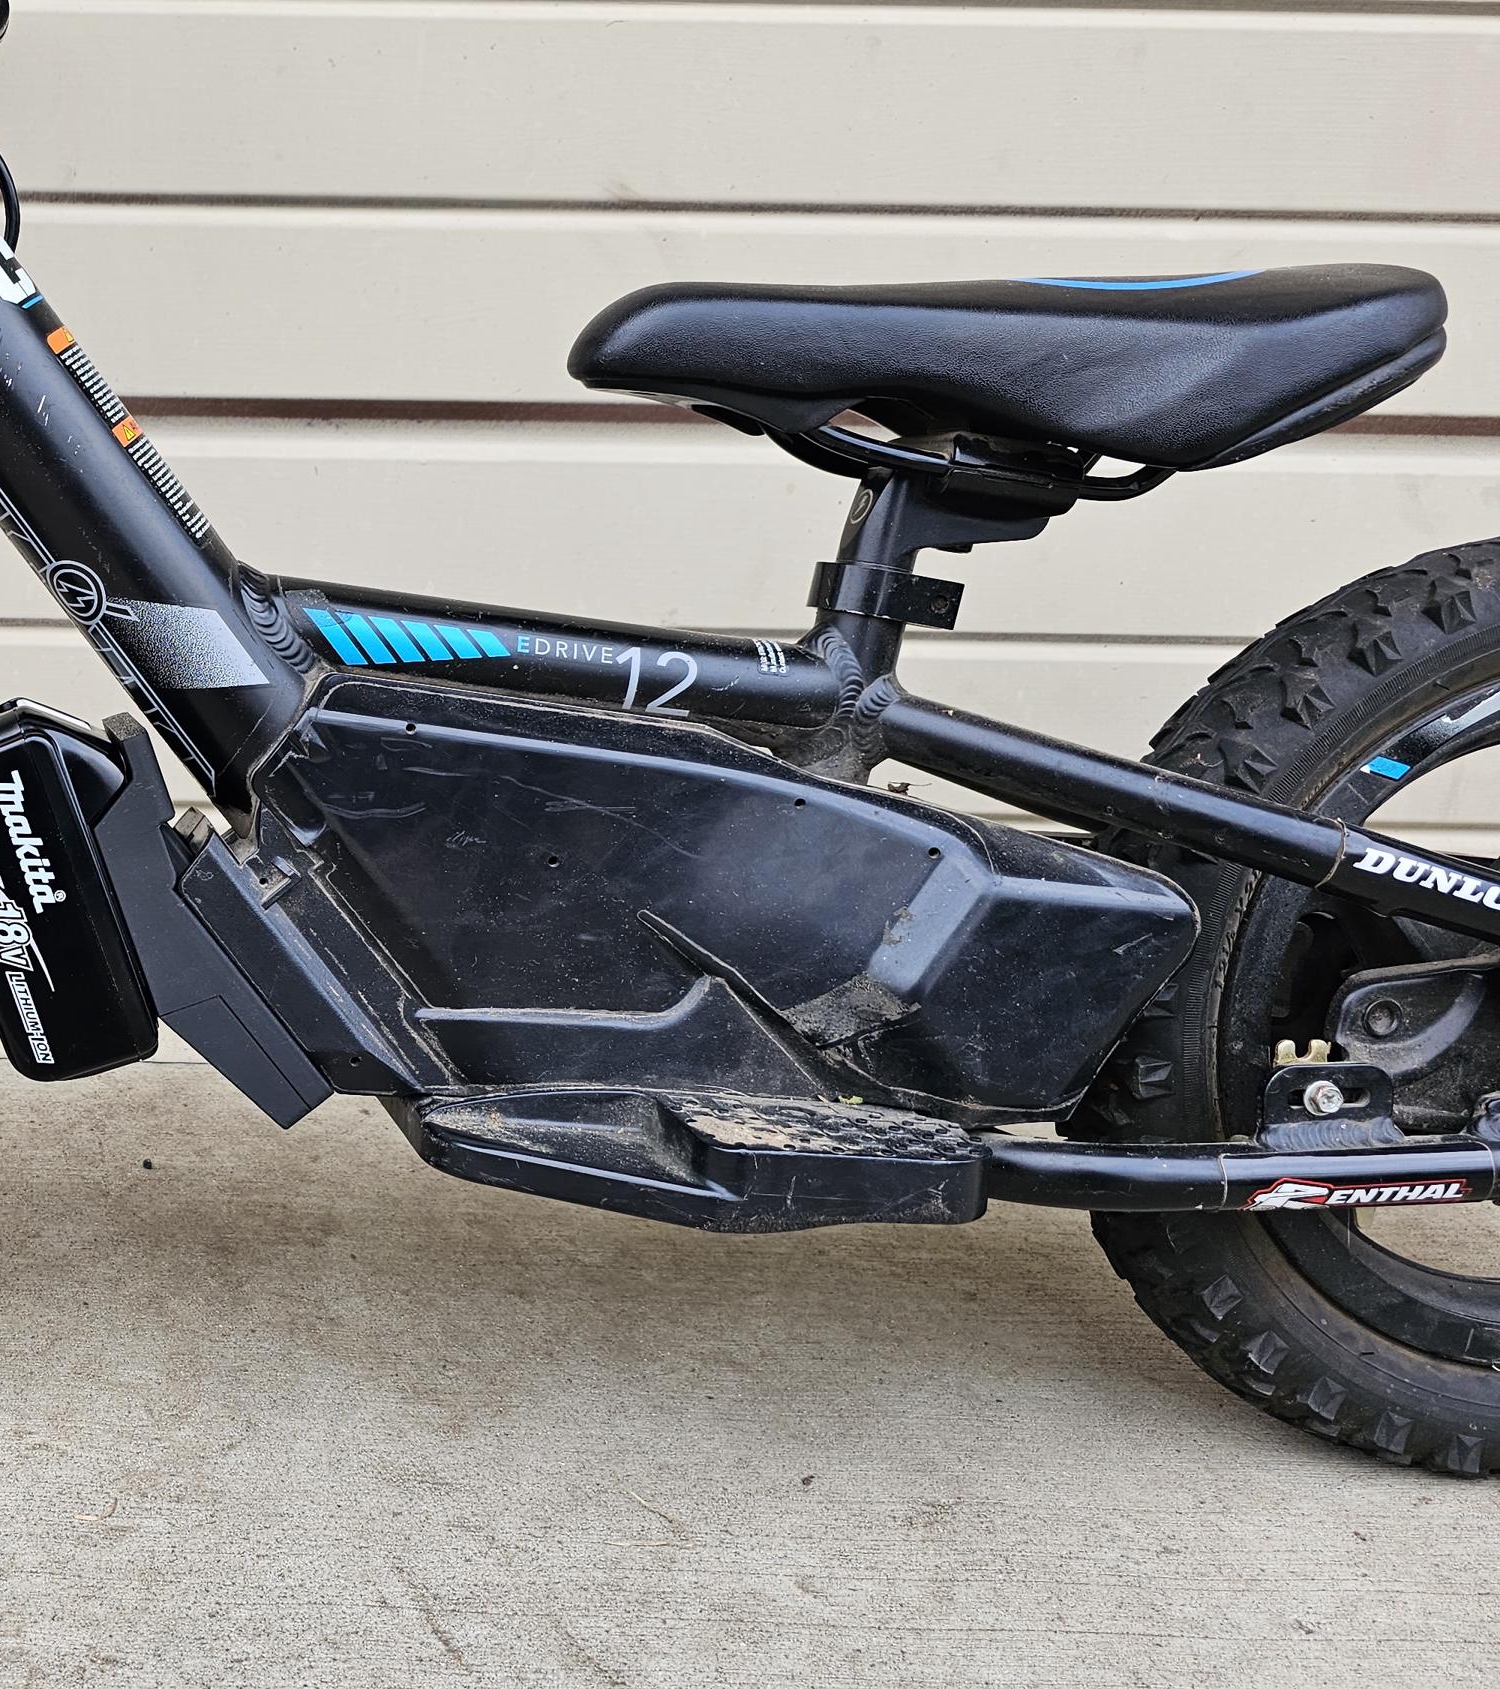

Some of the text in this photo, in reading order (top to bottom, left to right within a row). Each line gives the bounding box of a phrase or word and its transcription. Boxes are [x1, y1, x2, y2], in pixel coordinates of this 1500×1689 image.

[517, 635, 614, 664] EDRIVE
[615, 647, 698, 717] 12
[6, 972, 54, 1064] LITHIUM-ION
[1250, 1182, 1464, 1211] RENTHAL
